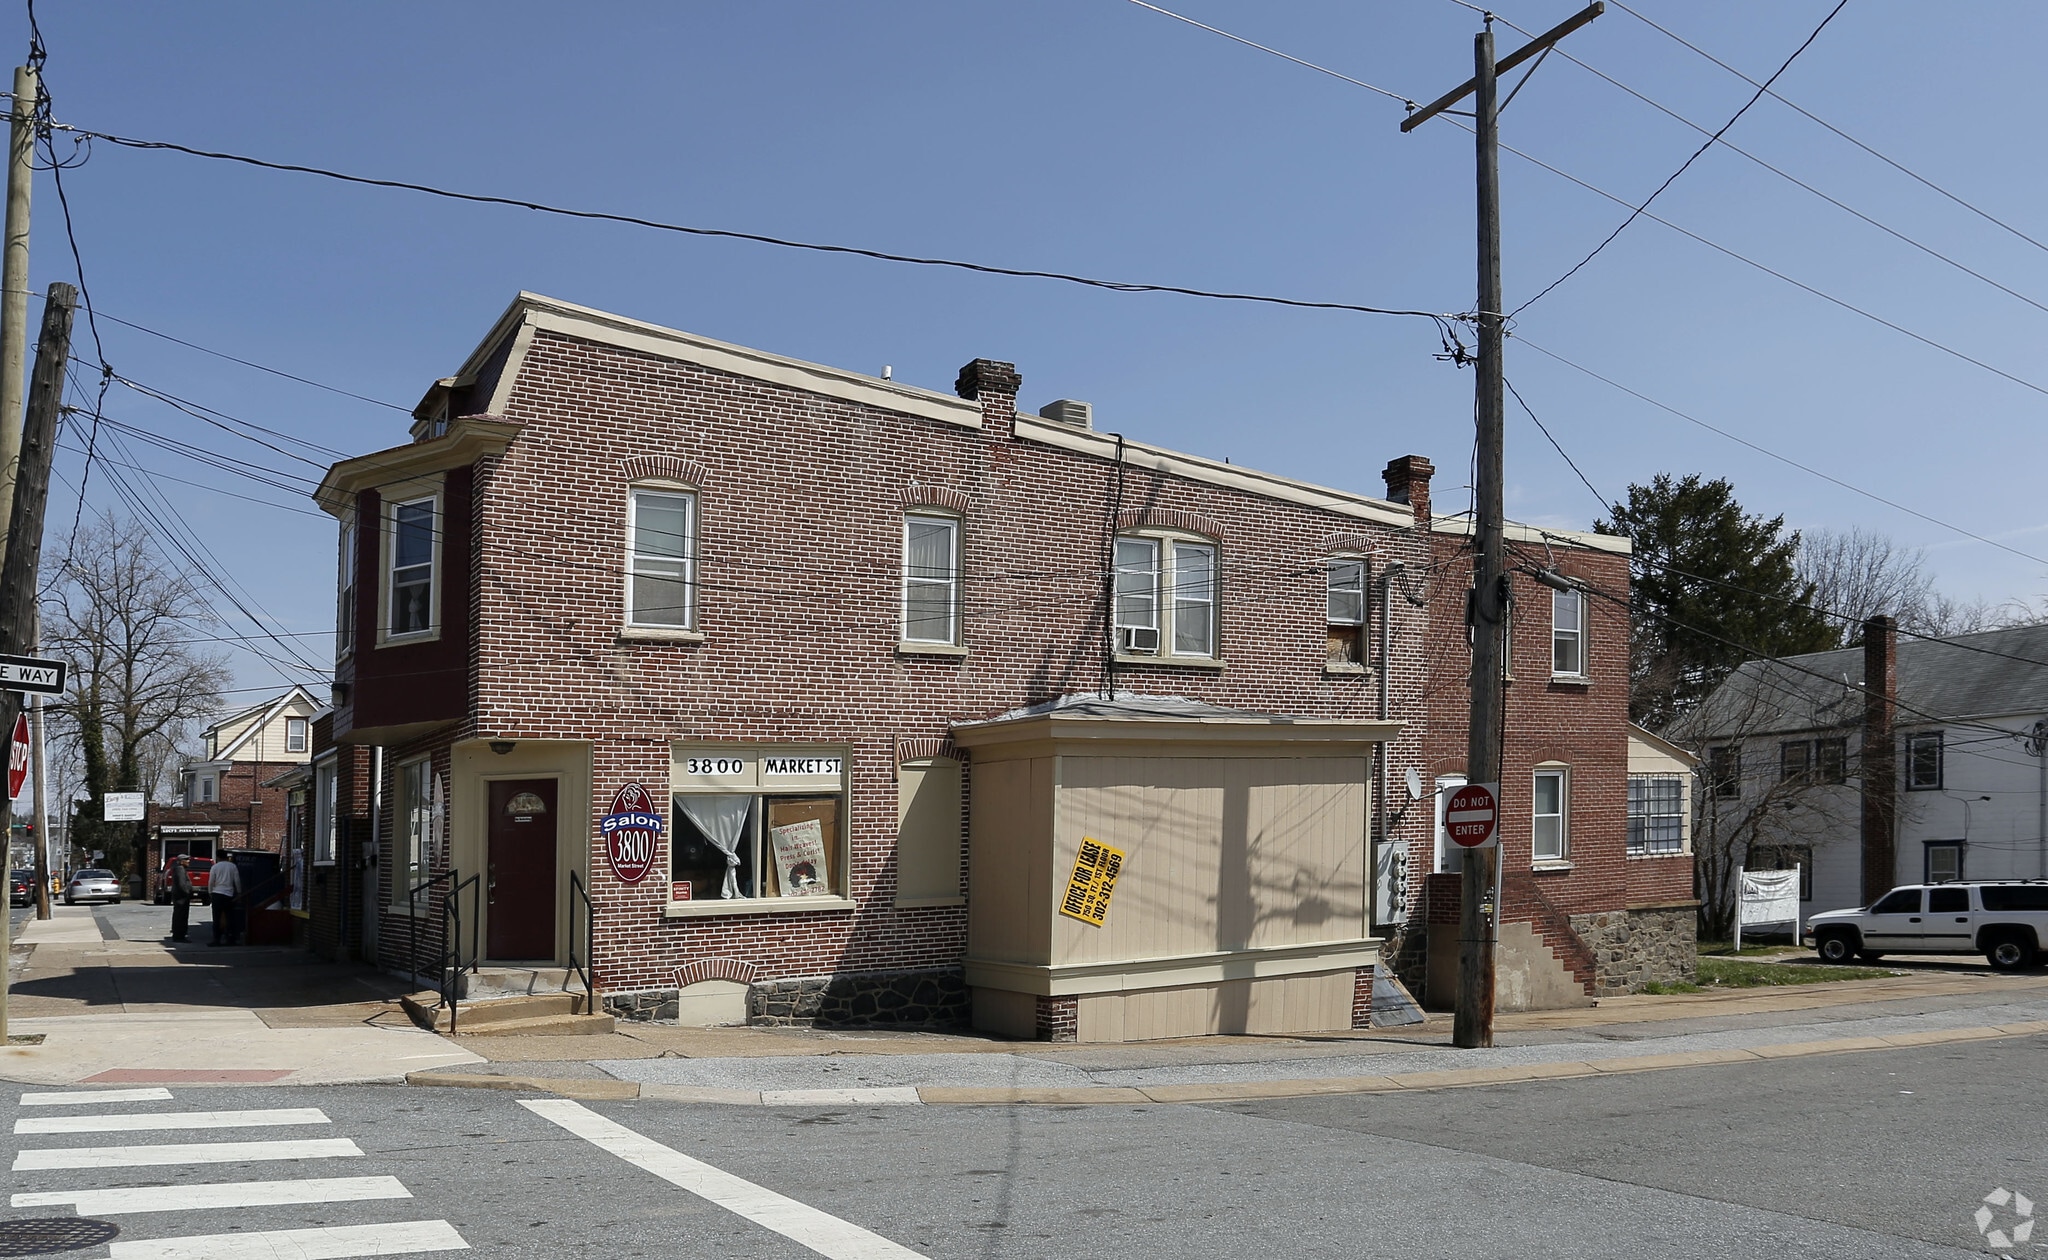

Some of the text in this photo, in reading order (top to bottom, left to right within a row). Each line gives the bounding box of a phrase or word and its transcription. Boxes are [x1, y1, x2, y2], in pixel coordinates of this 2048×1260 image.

[20, 667, 54, 683] WAY
[10, 741, 27, 771] STOP
[688, 758, 743, 774] 3800
[765, 759, 842, 773] MARKET ST.
[1453, 796, 1489, 808] DO NOT
[603, 813, 660, 832] Salon
[779, 823, 814, 835] Specializing
[1455, 824, 1484, 835] ENTER
[615, 830, 649, 862] 3800
[780, 845, 793, 853] Hair
[780, 854, 796, 862] Press
[1098, 848, 1110, 868] FLOOR
[1063, 841, 1101, 914] OFFICE FOR LEASE
[1092, 853, 1122, 921] 302-312-4569
